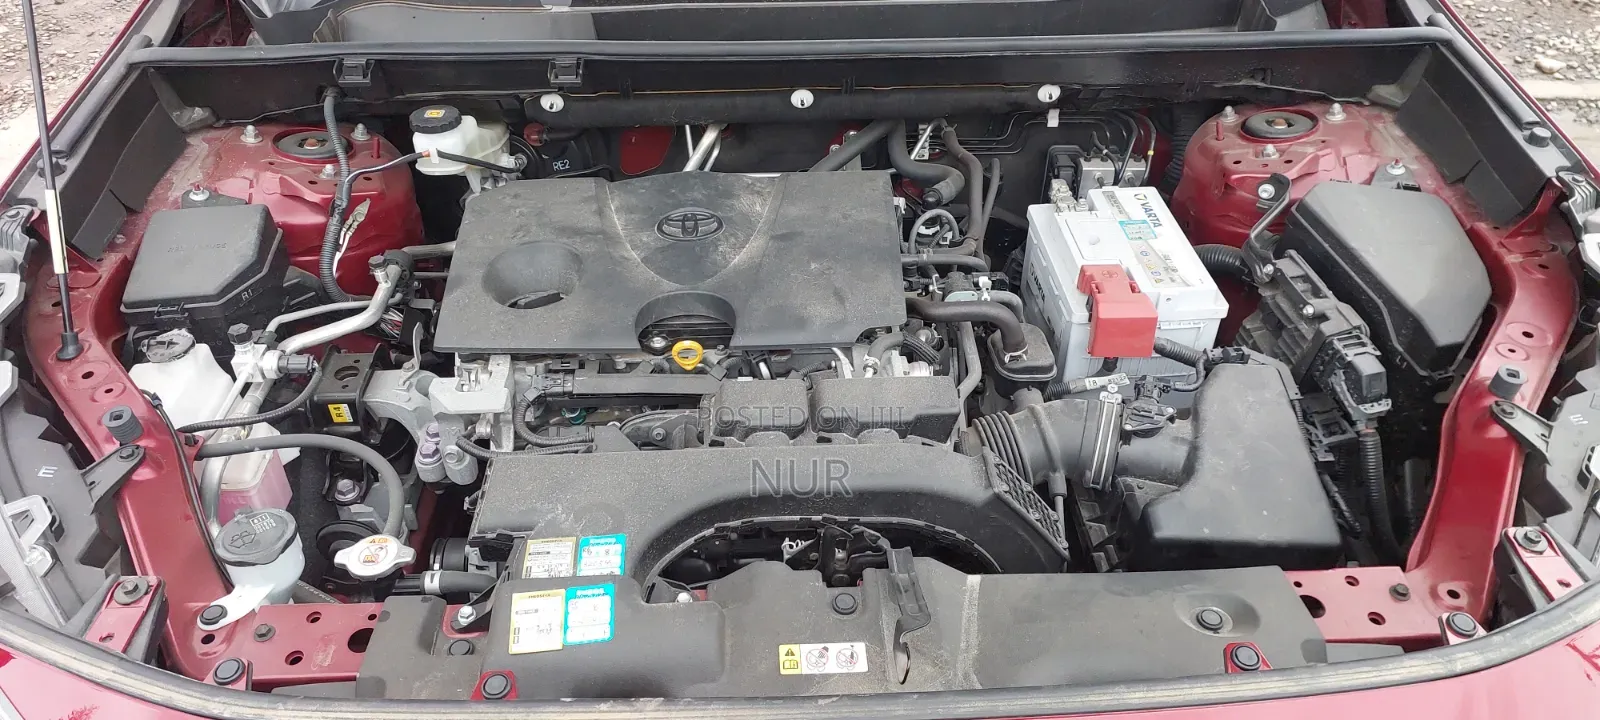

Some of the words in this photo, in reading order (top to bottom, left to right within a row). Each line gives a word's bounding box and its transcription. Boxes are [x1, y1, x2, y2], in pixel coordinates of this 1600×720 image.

[552, 160, 570, 171] RE2
[1141, 201, 1162, 228] VARTA
[241, 288, 253, 301] R1
[37, 465, 58, 478] E
